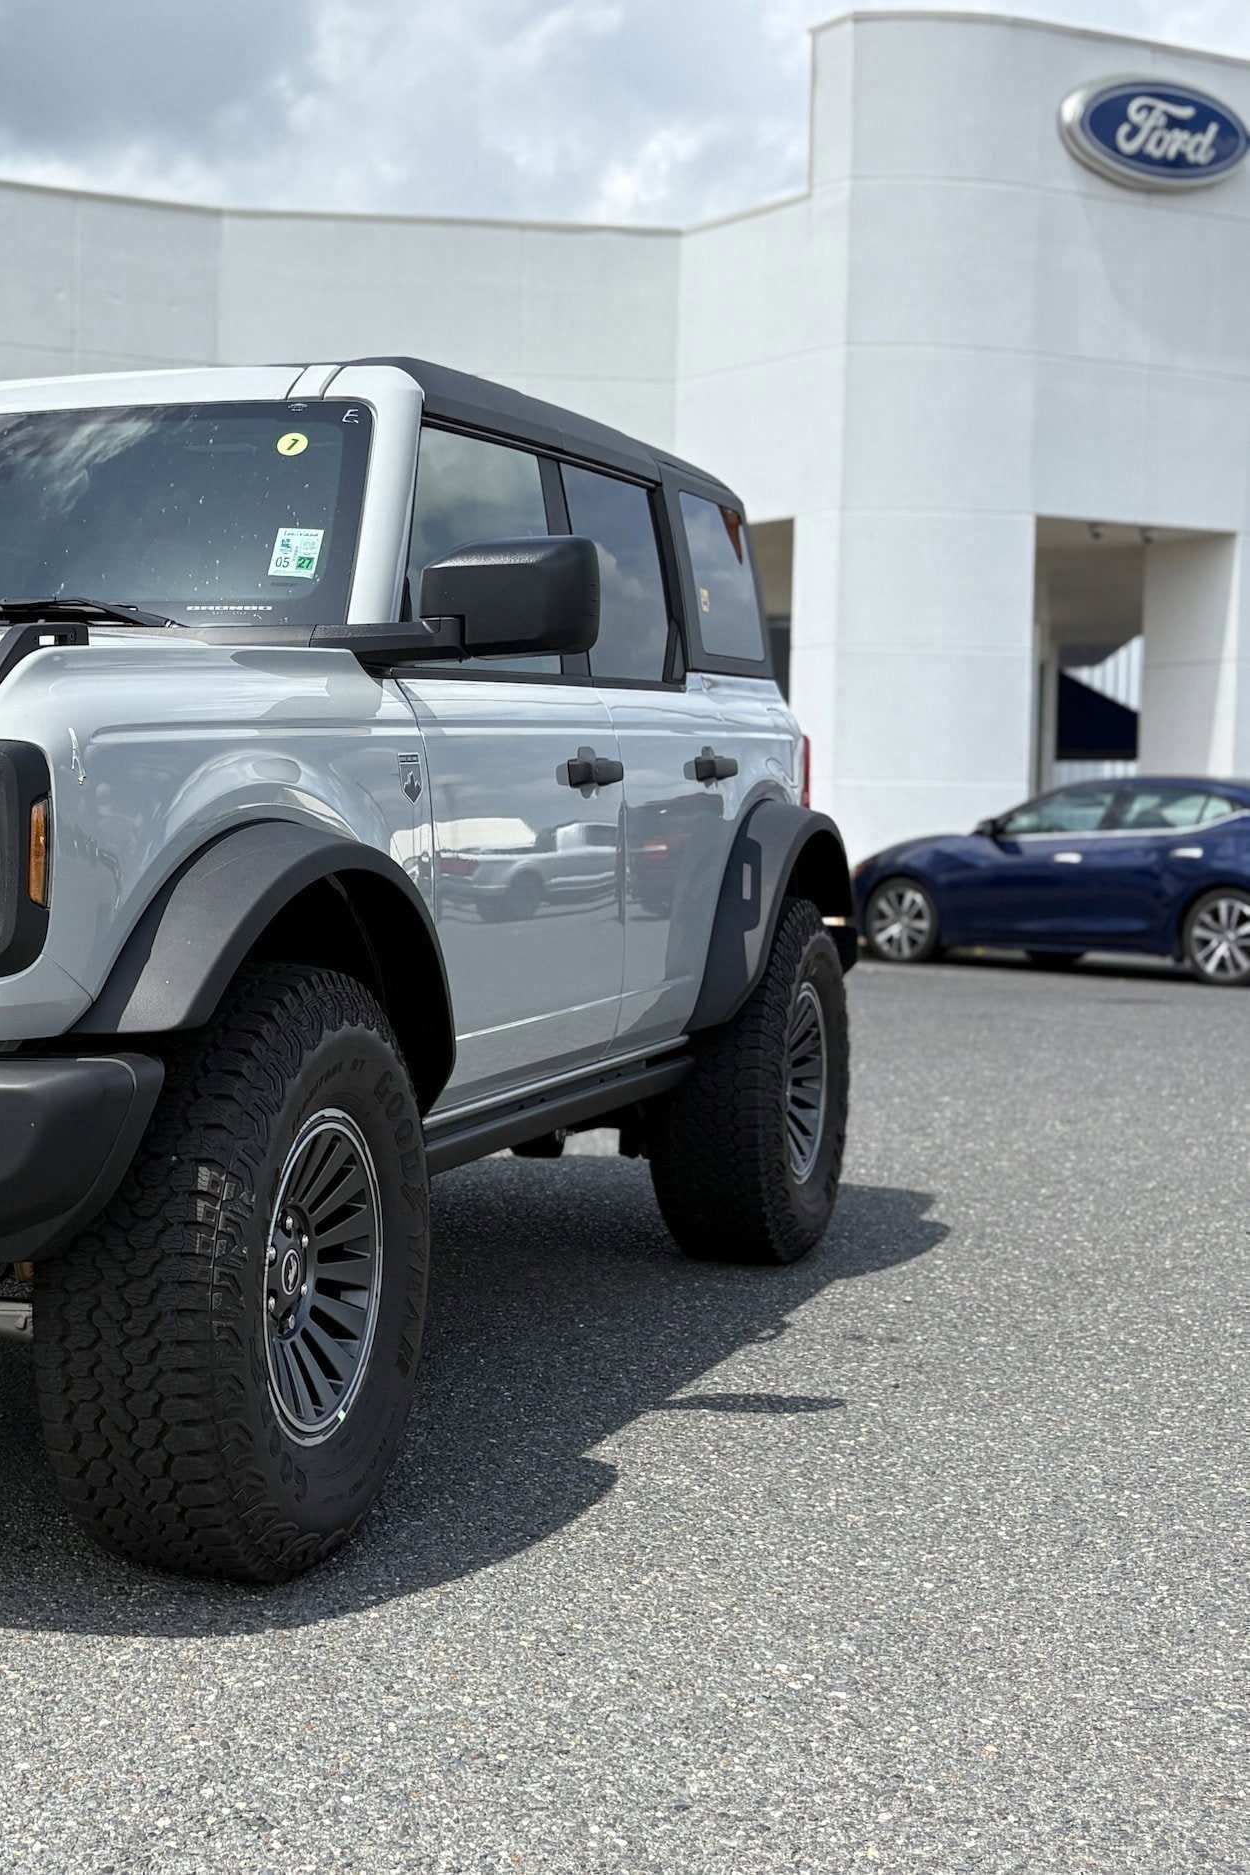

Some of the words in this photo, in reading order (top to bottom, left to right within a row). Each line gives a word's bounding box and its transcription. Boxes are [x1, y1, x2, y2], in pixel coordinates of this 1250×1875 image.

[1115, 96, 1219, 164] Ford
[275, 556, 290, 568] 05
[297, 557, 314, 569] 27
